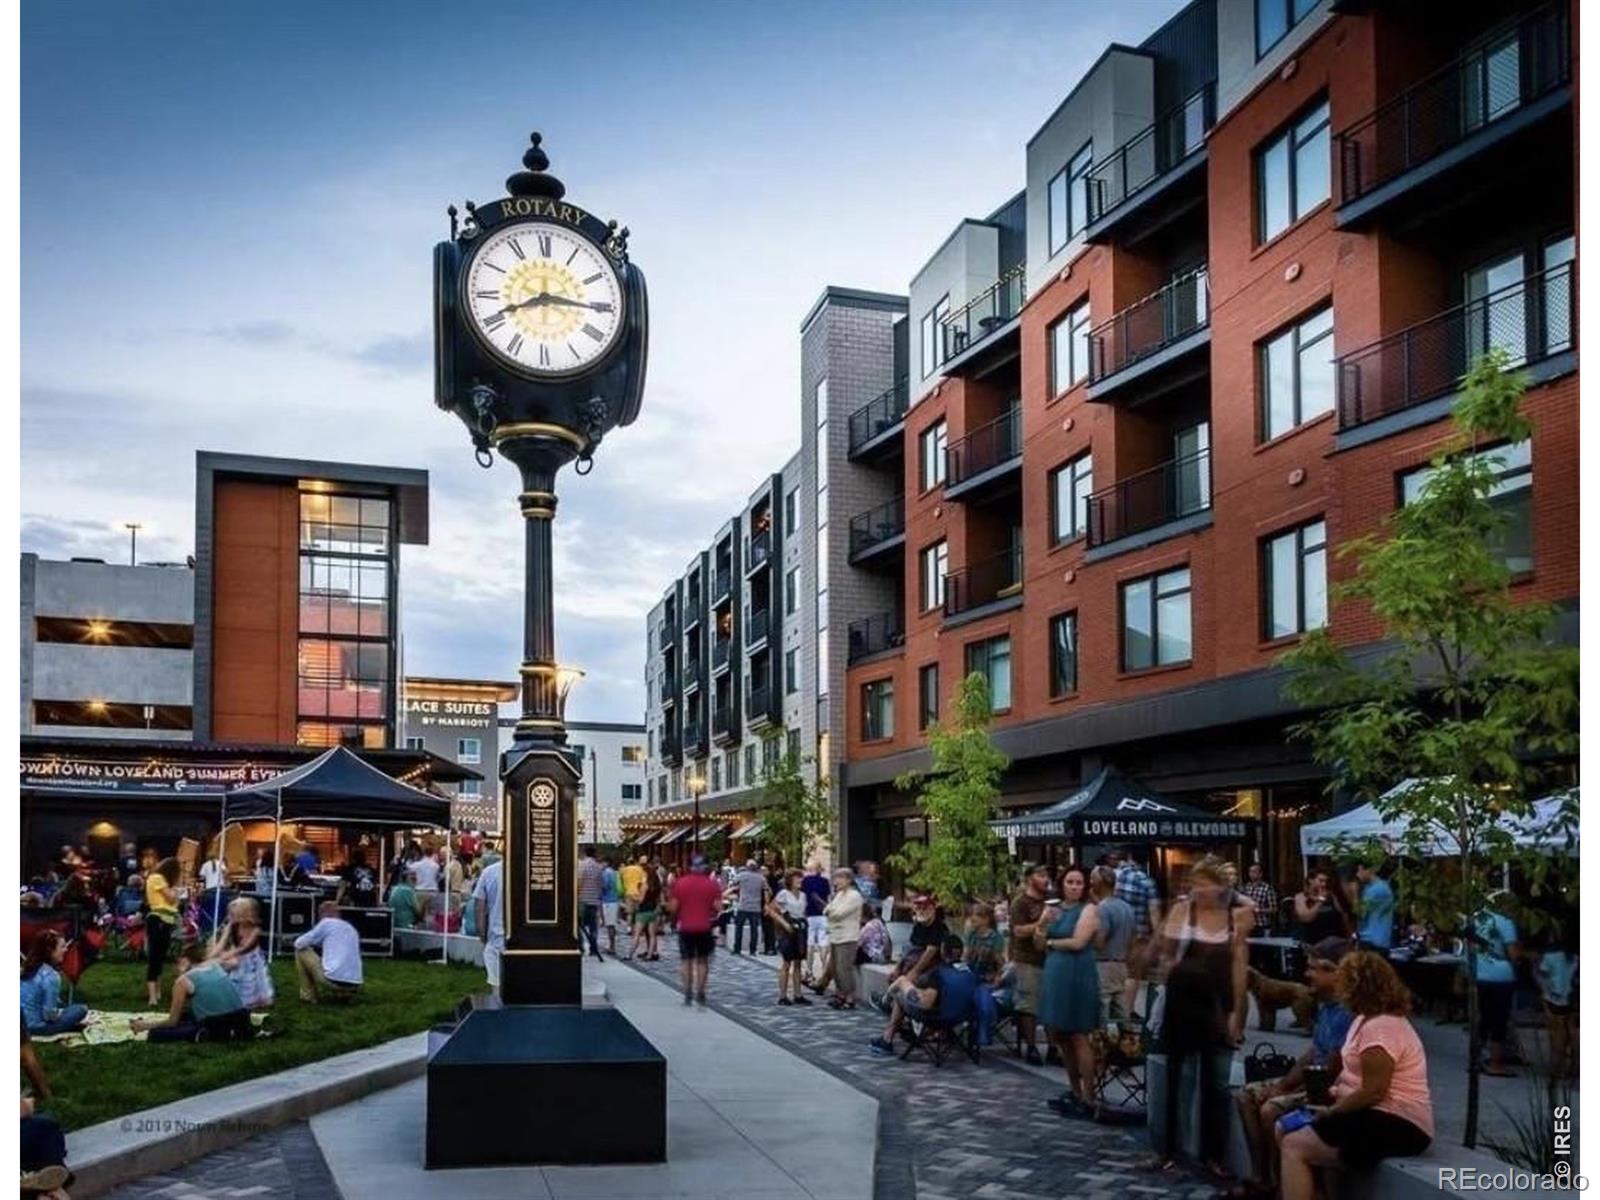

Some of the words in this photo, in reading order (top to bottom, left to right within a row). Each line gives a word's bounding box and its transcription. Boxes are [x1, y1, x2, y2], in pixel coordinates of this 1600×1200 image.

[501, 199, 588, 225] ROTARY
[444, 702, 491, 715] SUITES
[422, 716, 435, 725] BY
[438, 717, 490, 728] MARRIOTT
[104, 765, 184, 779] LOVELAND
[186, 769, 247, 781] SUMMER
[1083, 820, 1158, 835] LOVELAND
[1174, 822, 1246, 837] ALEWORKS
